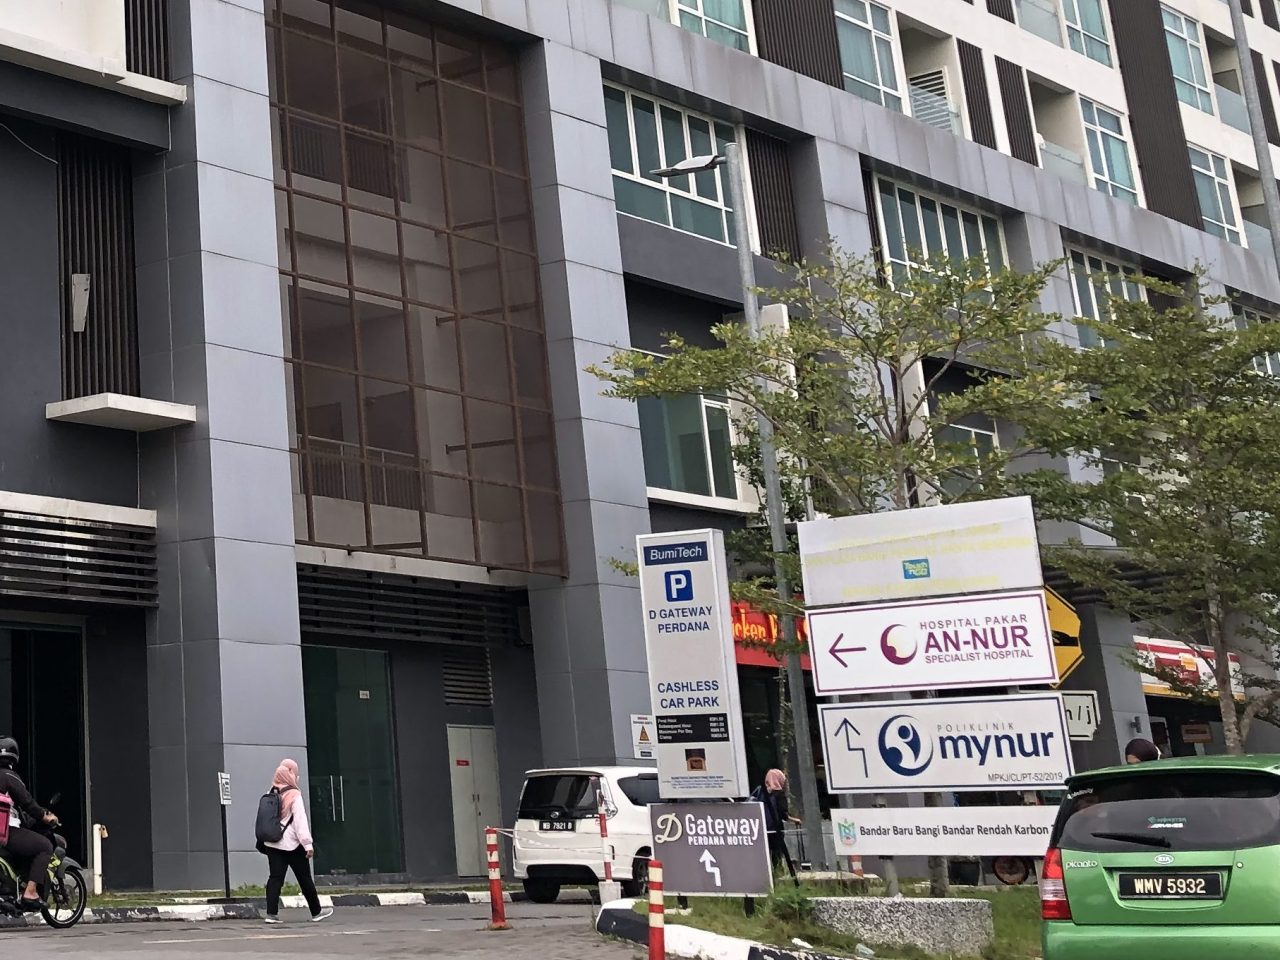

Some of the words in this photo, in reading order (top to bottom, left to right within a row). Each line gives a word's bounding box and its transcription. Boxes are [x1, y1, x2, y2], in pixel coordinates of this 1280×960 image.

[650, 546, 702, 560] BumiTech
[669, 573, 687, 599] P
[648, 609, 657, 620] D
[659, 606, 712, 619] GATEWAY
[658, 621, 710, 634] PERDANA
[919, 618, 980, 630] HOSPITAL
[985, 614, 1028, 626] PAKAR
[924, 625, 1032, 654] AN-NUR
[925, 652, 981, 664] SPECIALIST
[984, 649, 1034, 661] HOSPITAL
[657, 680, 719, 693] CASHLESS
[660, 698, 685, 709] CAR
[688, 696, 719, 708] PARK
[936, 722, 1014, 733] POLIKLINIK
[938, 731, 1054, 766] mynur
[654, 812, 683, 844] D
[685, 813, 760, 841] Gateway
[859, 826, 891, 836] Bandar
[892, 825, 914, 836] Baru
[915, 825, 941, 838] Bangi
[942, 825, 975, 835] Bandar
[977, 824, 1013, 835] Rendah
[1014, 824, 1049, 835] Karbon
[687, 836, 725, 846] PERDANA
[726, 836, 754, 846] HOTEL
[1065, 859, 1098, 870] picanto
[1134, 878, 1163, 894] WMV
[1166, 878, 1207, 894] 5932
